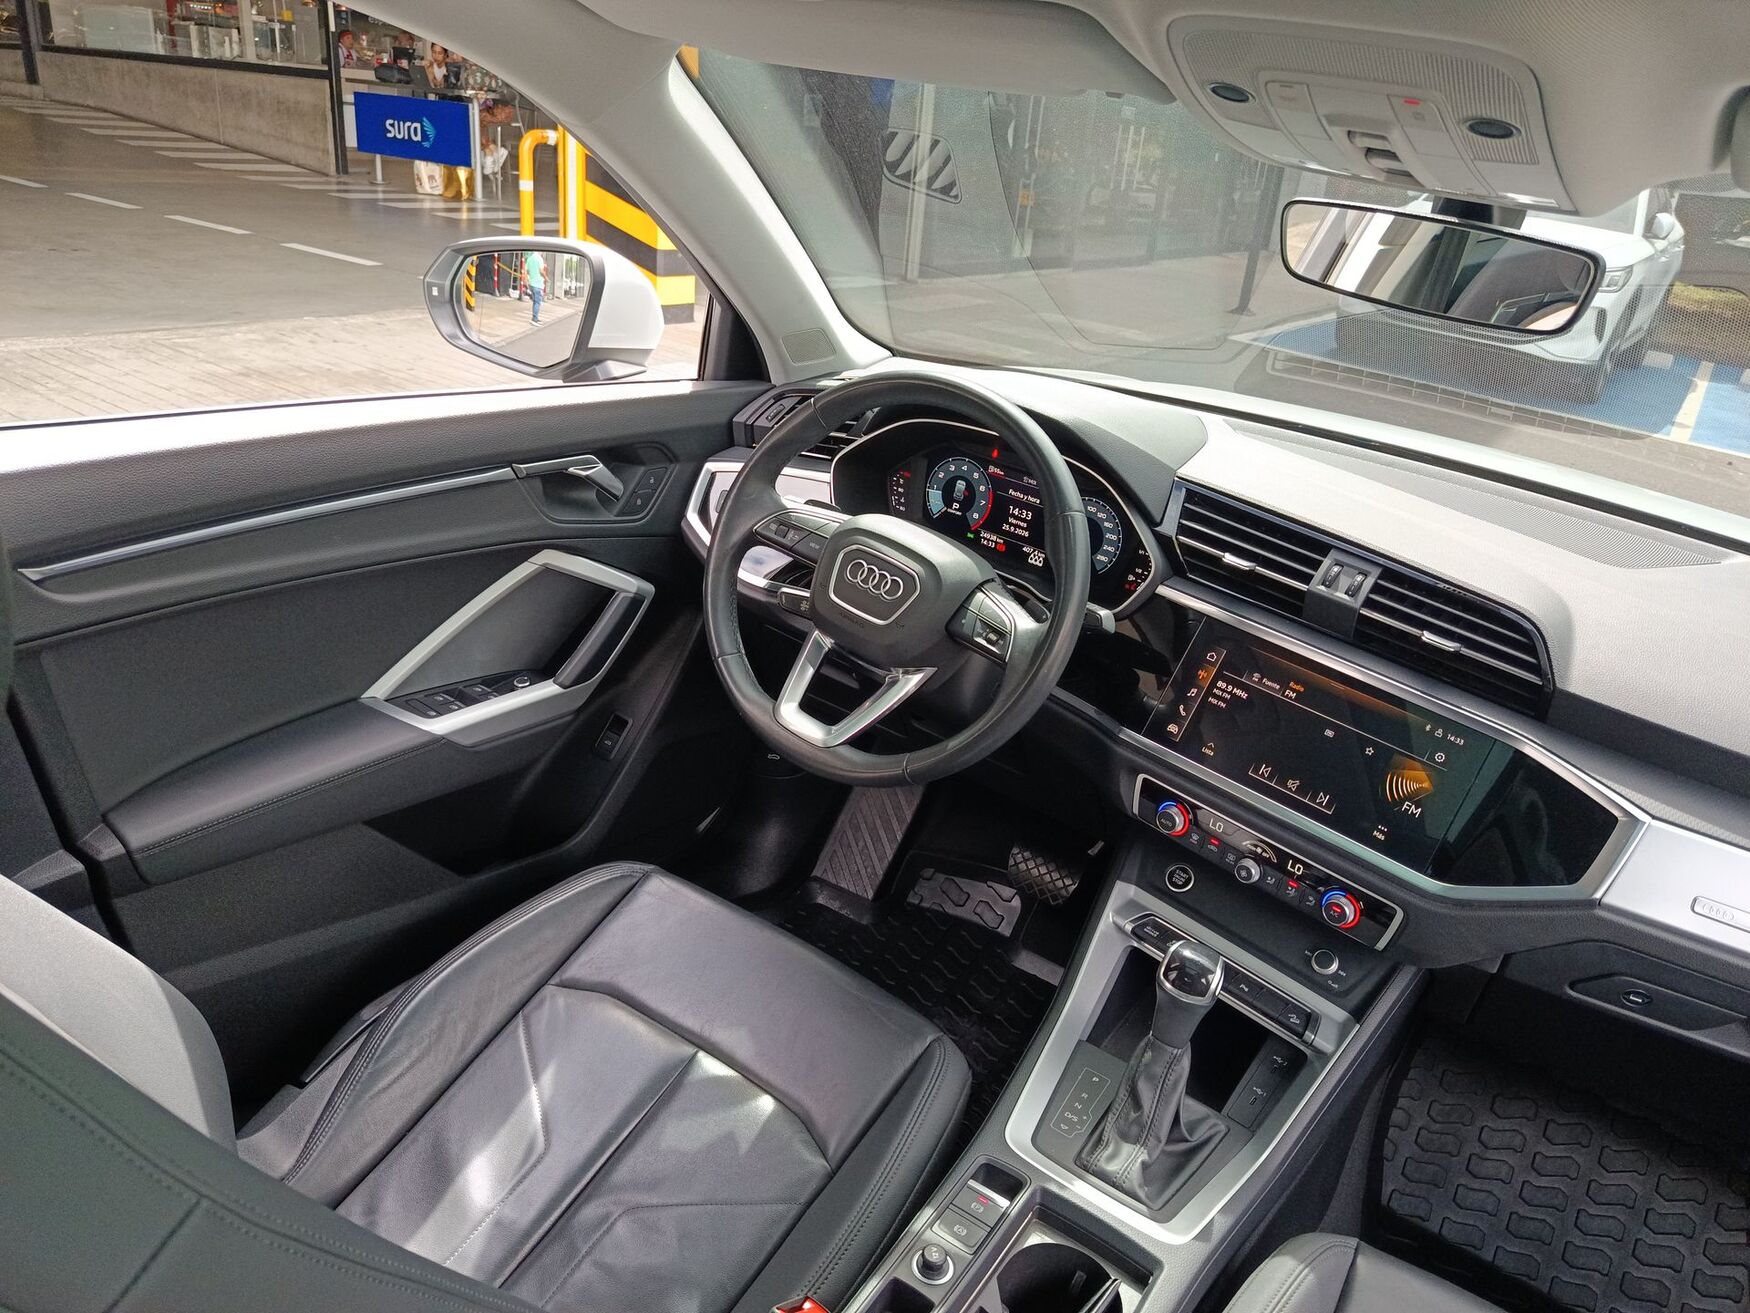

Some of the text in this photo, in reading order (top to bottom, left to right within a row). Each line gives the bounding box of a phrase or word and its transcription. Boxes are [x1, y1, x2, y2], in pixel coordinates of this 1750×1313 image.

[385, 119, 421, 142] sura
[1009, 488, 1024, 499] Fecha
[1028, 495, 1040, 504] hora
[1009, 505, 1032, 520] 14:33
[1008, 516, 1028, 528] Viernes
[1002, 523, 1029, 538] 25.9.2026
[1105, 533, 1118, 541] 200
[1103, 544, 1115, 553] 240
[1216, 680, 1249, 700] 89.9 MHz
[1262, 677, 1281, 690] Fuente
[1289, 681, 1305, 692] Radio
[1284, 689, 1297, 700] FM
[1446, 733, 1465, 746] 14:33
[1201, 746, 1214, 756] Lista
[1401, 801, 1422, 818] FM
[1160, 818, 1173, 827] AUTO
[1209, 818, 1224, 833] LO
[1287, 859, 1304, 876] LO
[1064, 1111, 1079, 1122] D/S
